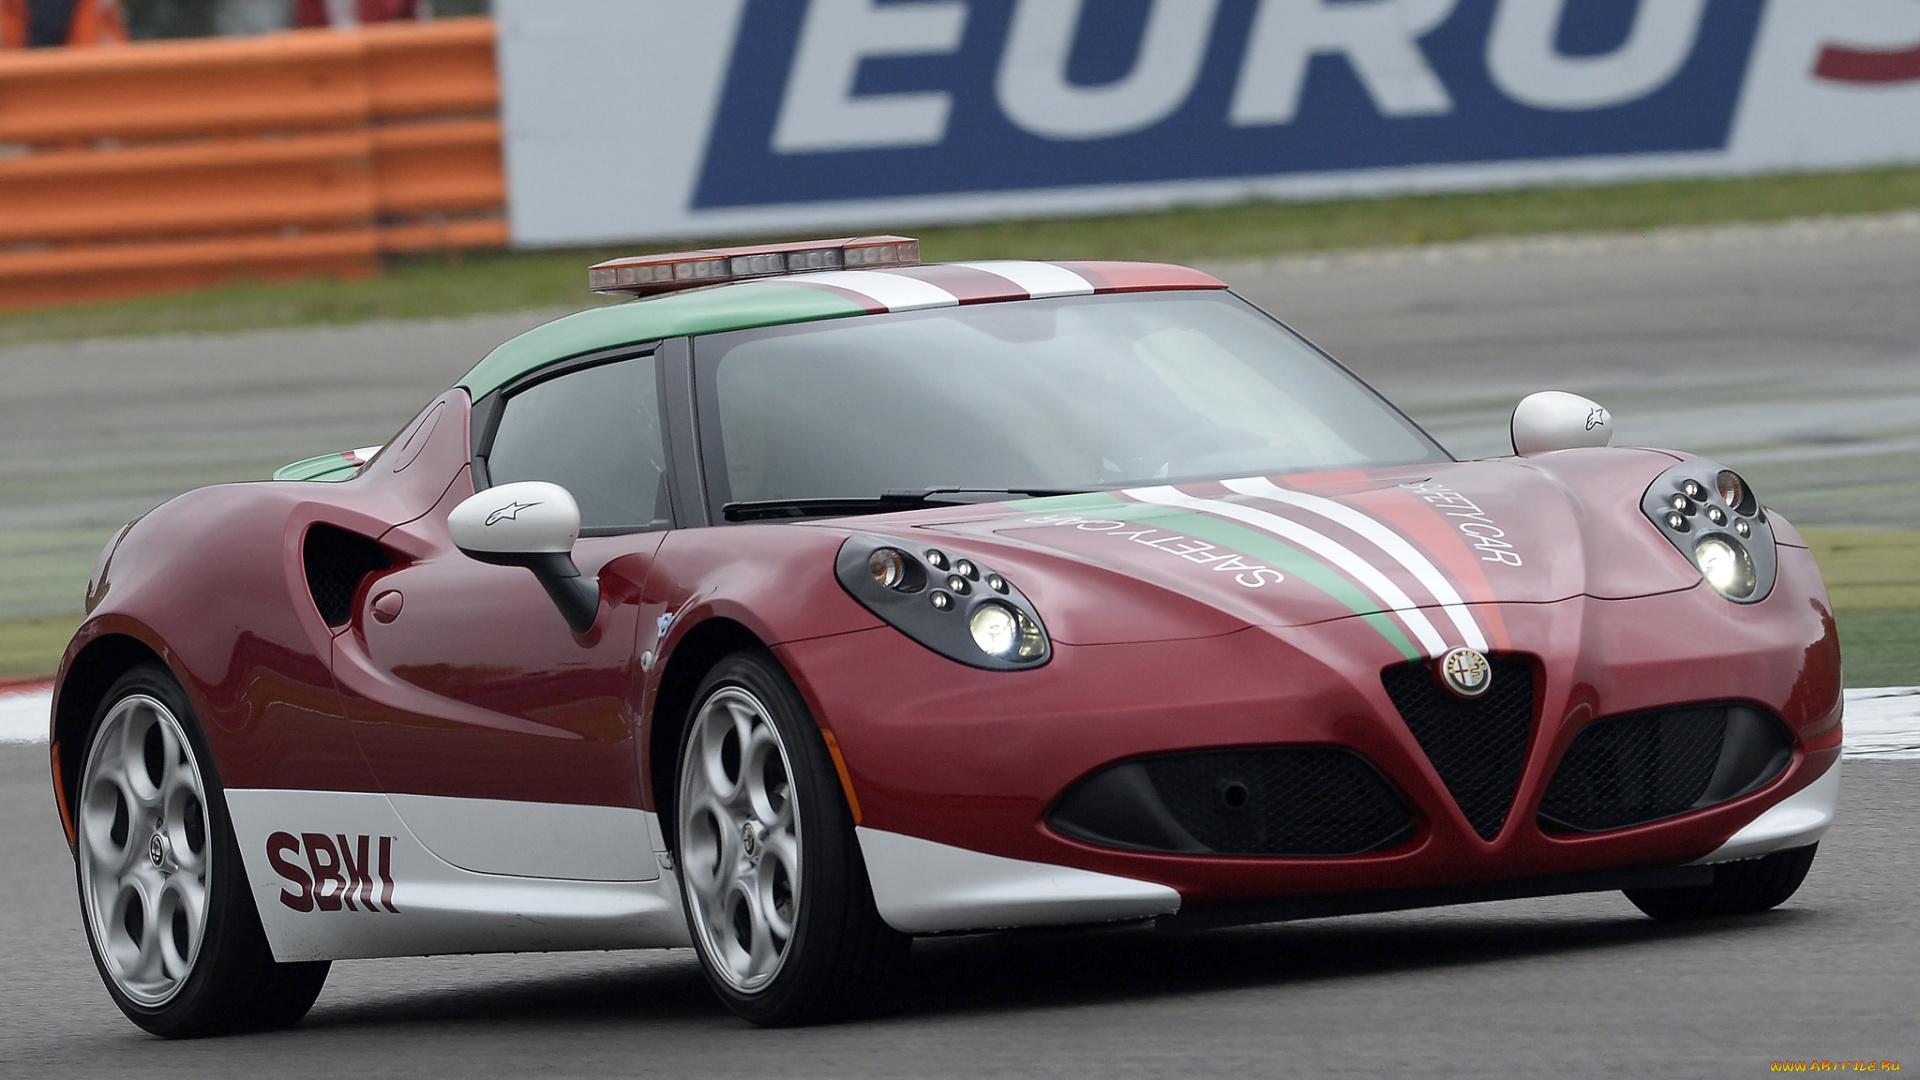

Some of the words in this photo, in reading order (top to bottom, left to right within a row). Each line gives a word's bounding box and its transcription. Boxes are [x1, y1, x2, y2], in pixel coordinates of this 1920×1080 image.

[1024, 515, 1126, 531] CAR
[1459, 522, 1523, 567] CAR
[1107, 529, 1285, 588] SAFETY
